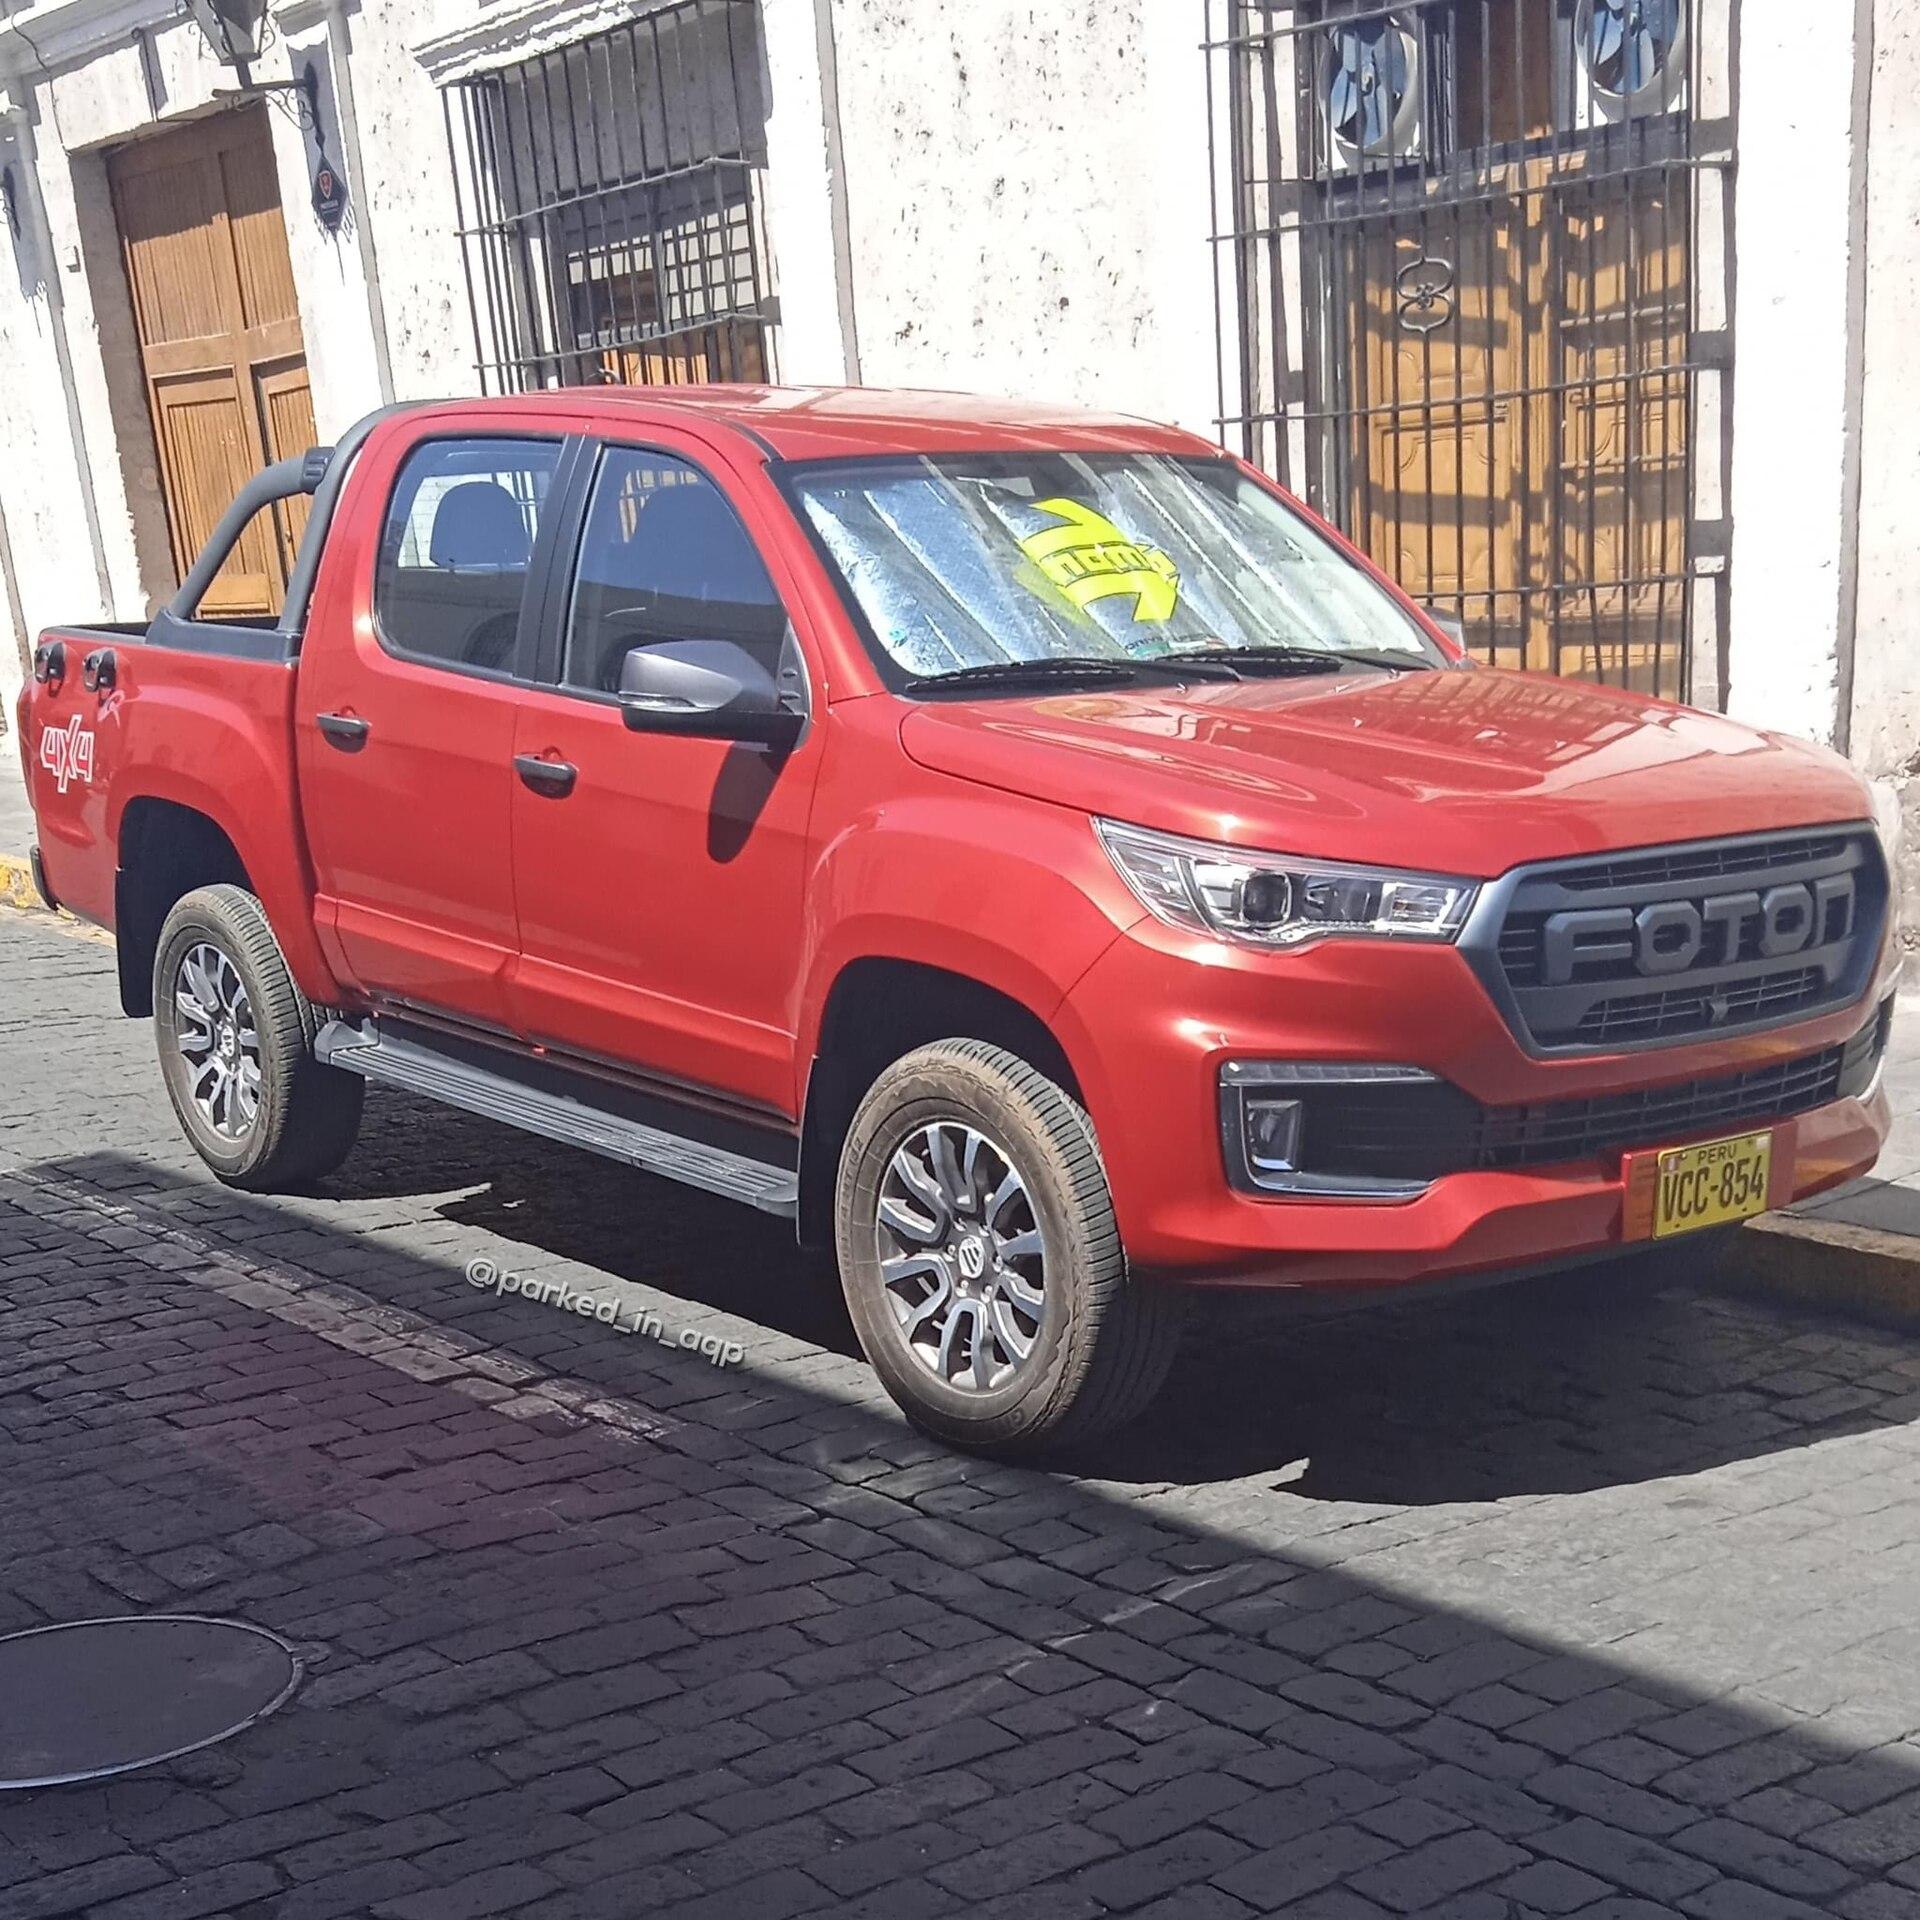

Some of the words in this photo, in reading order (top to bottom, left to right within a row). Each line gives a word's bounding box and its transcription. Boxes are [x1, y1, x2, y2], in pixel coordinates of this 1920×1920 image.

[1545, 873, 1856, 985] FOTON
[1697, 1143, 1737, 1164] PERU
[1663, 1155, 1763, 1222] VCC-854
